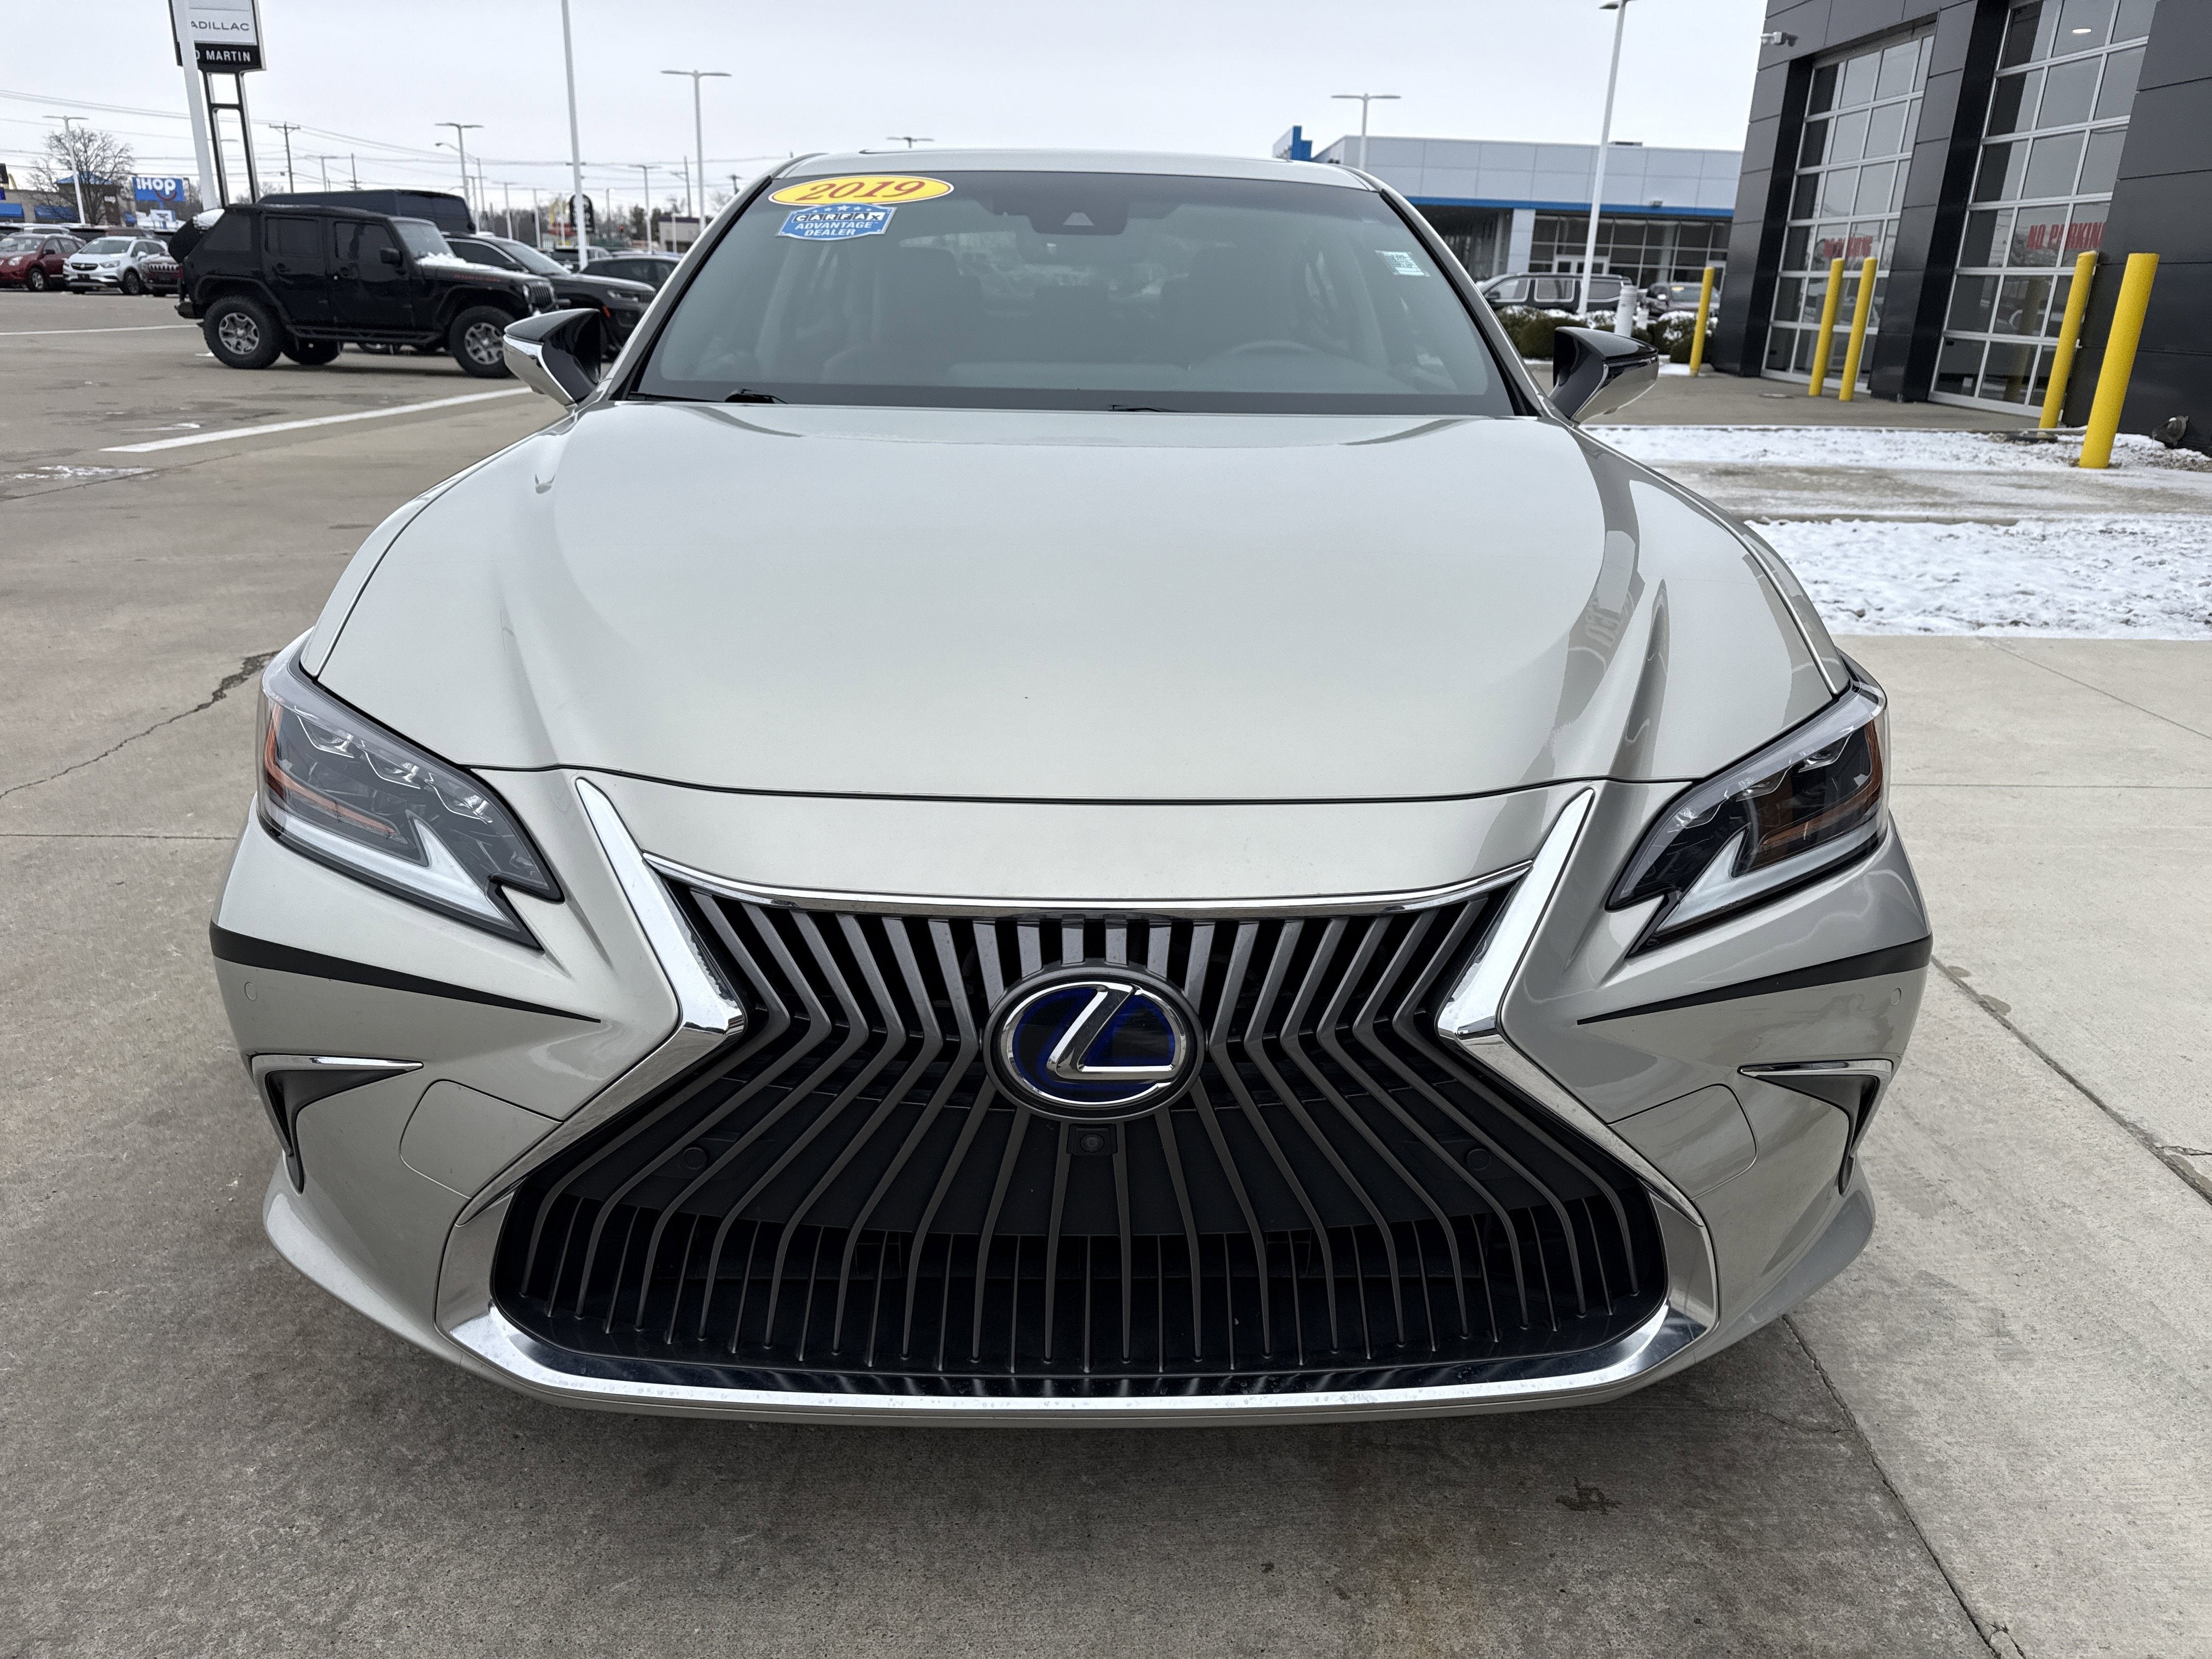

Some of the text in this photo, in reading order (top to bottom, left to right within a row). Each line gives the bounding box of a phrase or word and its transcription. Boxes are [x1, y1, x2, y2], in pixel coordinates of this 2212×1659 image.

[190, 20, 250, 31] ADILLAC
[206, 49, 251, 63] MARTIN
[795, 180, 926, 201] 2019
[795, 212, 883, 222] CARFAX
[794, 221, 873, 230] ADVANTAGE
[804, 228, 856, 236] DEALER
[2027, 222, 2107, 250] NO PARKIN
